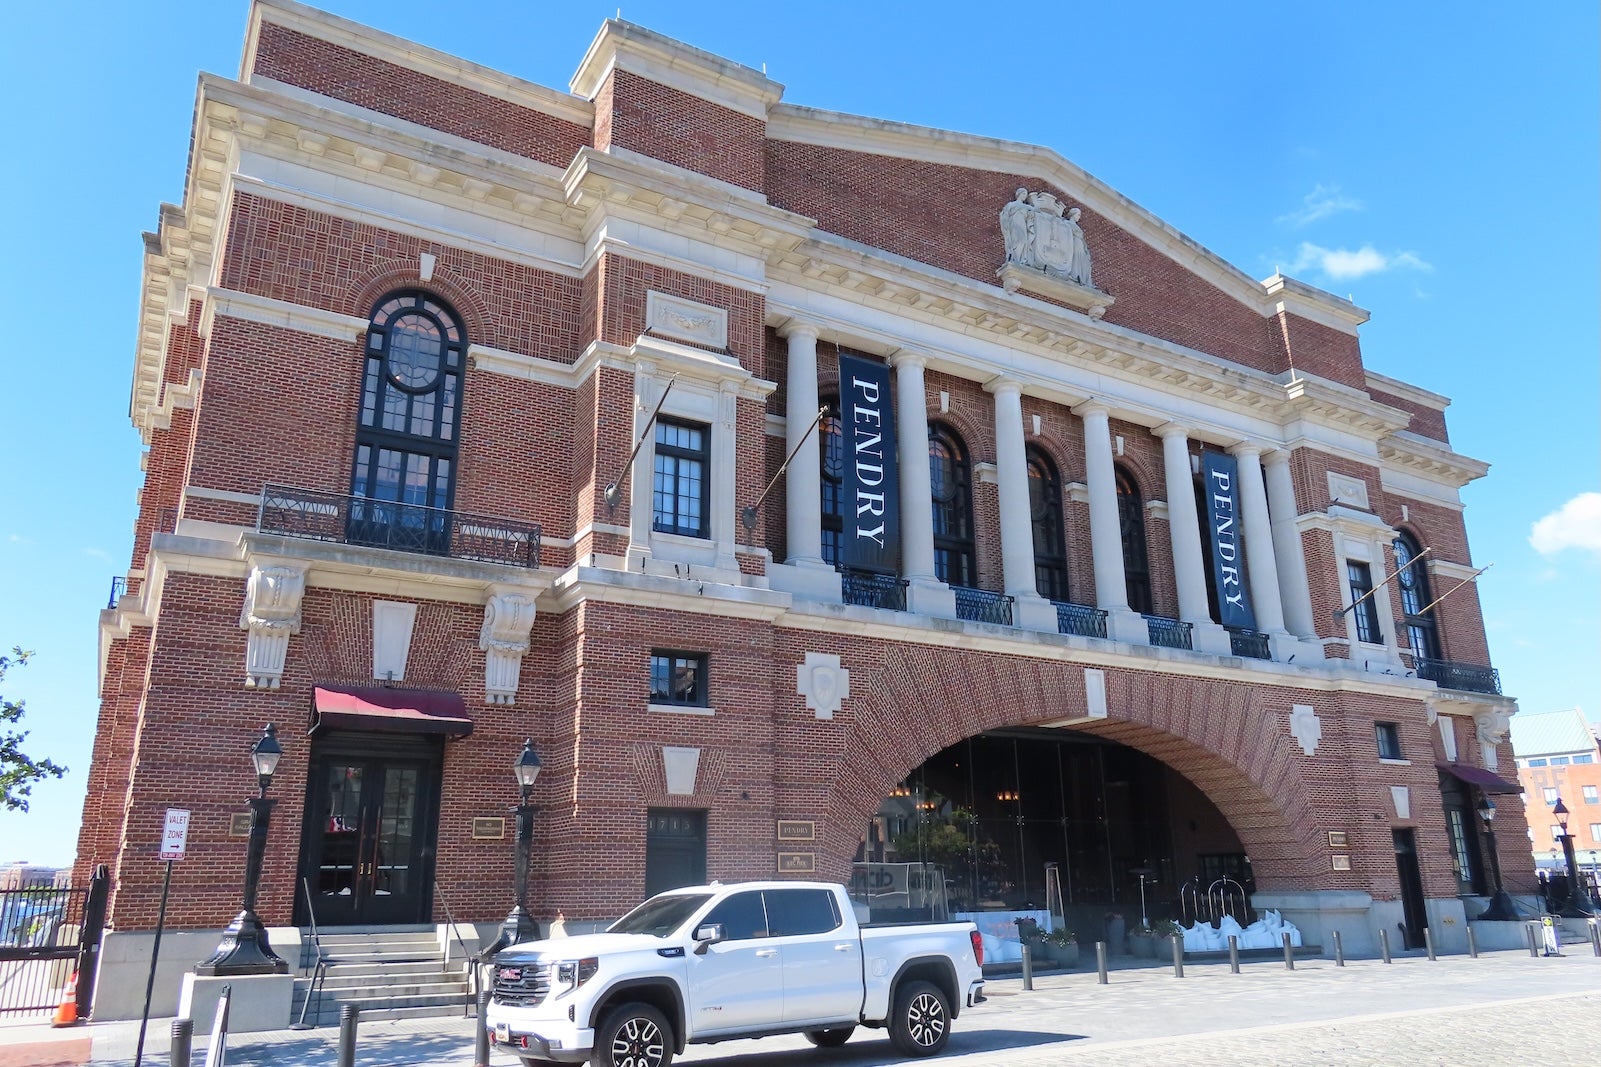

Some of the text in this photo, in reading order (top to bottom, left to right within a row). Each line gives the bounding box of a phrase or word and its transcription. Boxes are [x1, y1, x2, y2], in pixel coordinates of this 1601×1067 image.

[853, 376, 885, 548] PENDRY
[1211, 468, 1245, 611] PENDRY
[167, 830, 184, 839] ZONE
[169, 815, 187, 825] VALET
